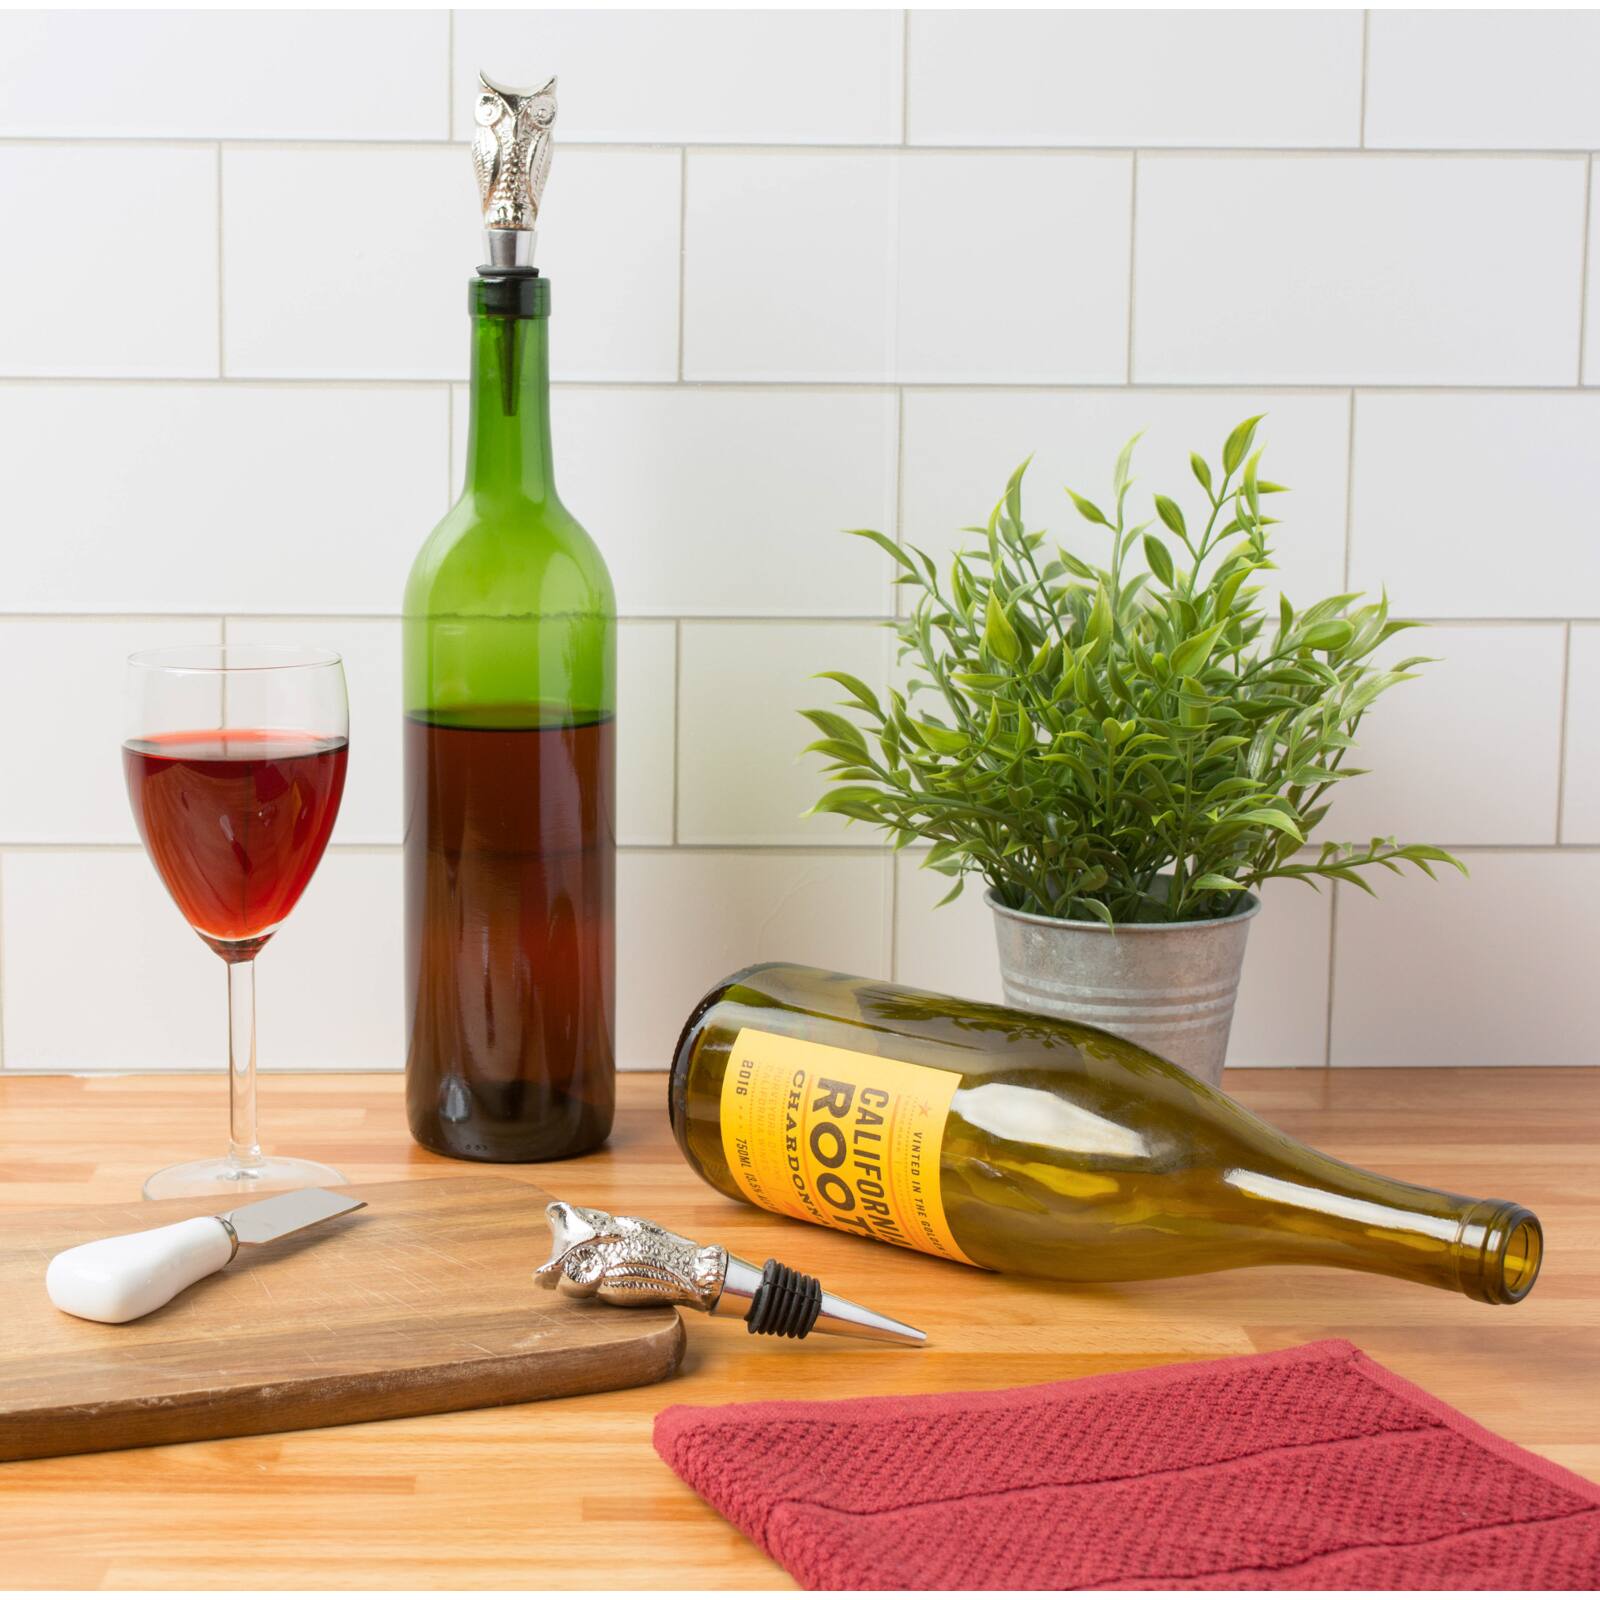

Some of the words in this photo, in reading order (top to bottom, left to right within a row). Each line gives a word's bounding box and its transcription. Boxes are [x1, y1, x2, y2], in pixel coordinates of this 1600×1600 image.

[736, 1060, 753, 1096] 2016
[736, 1137, 752, 1168] 750ML
[911, 1131, 923, 1176] VINTED
[911, 1180, 922, 1194] IN
[914, 1198, 927, 1218] THE
